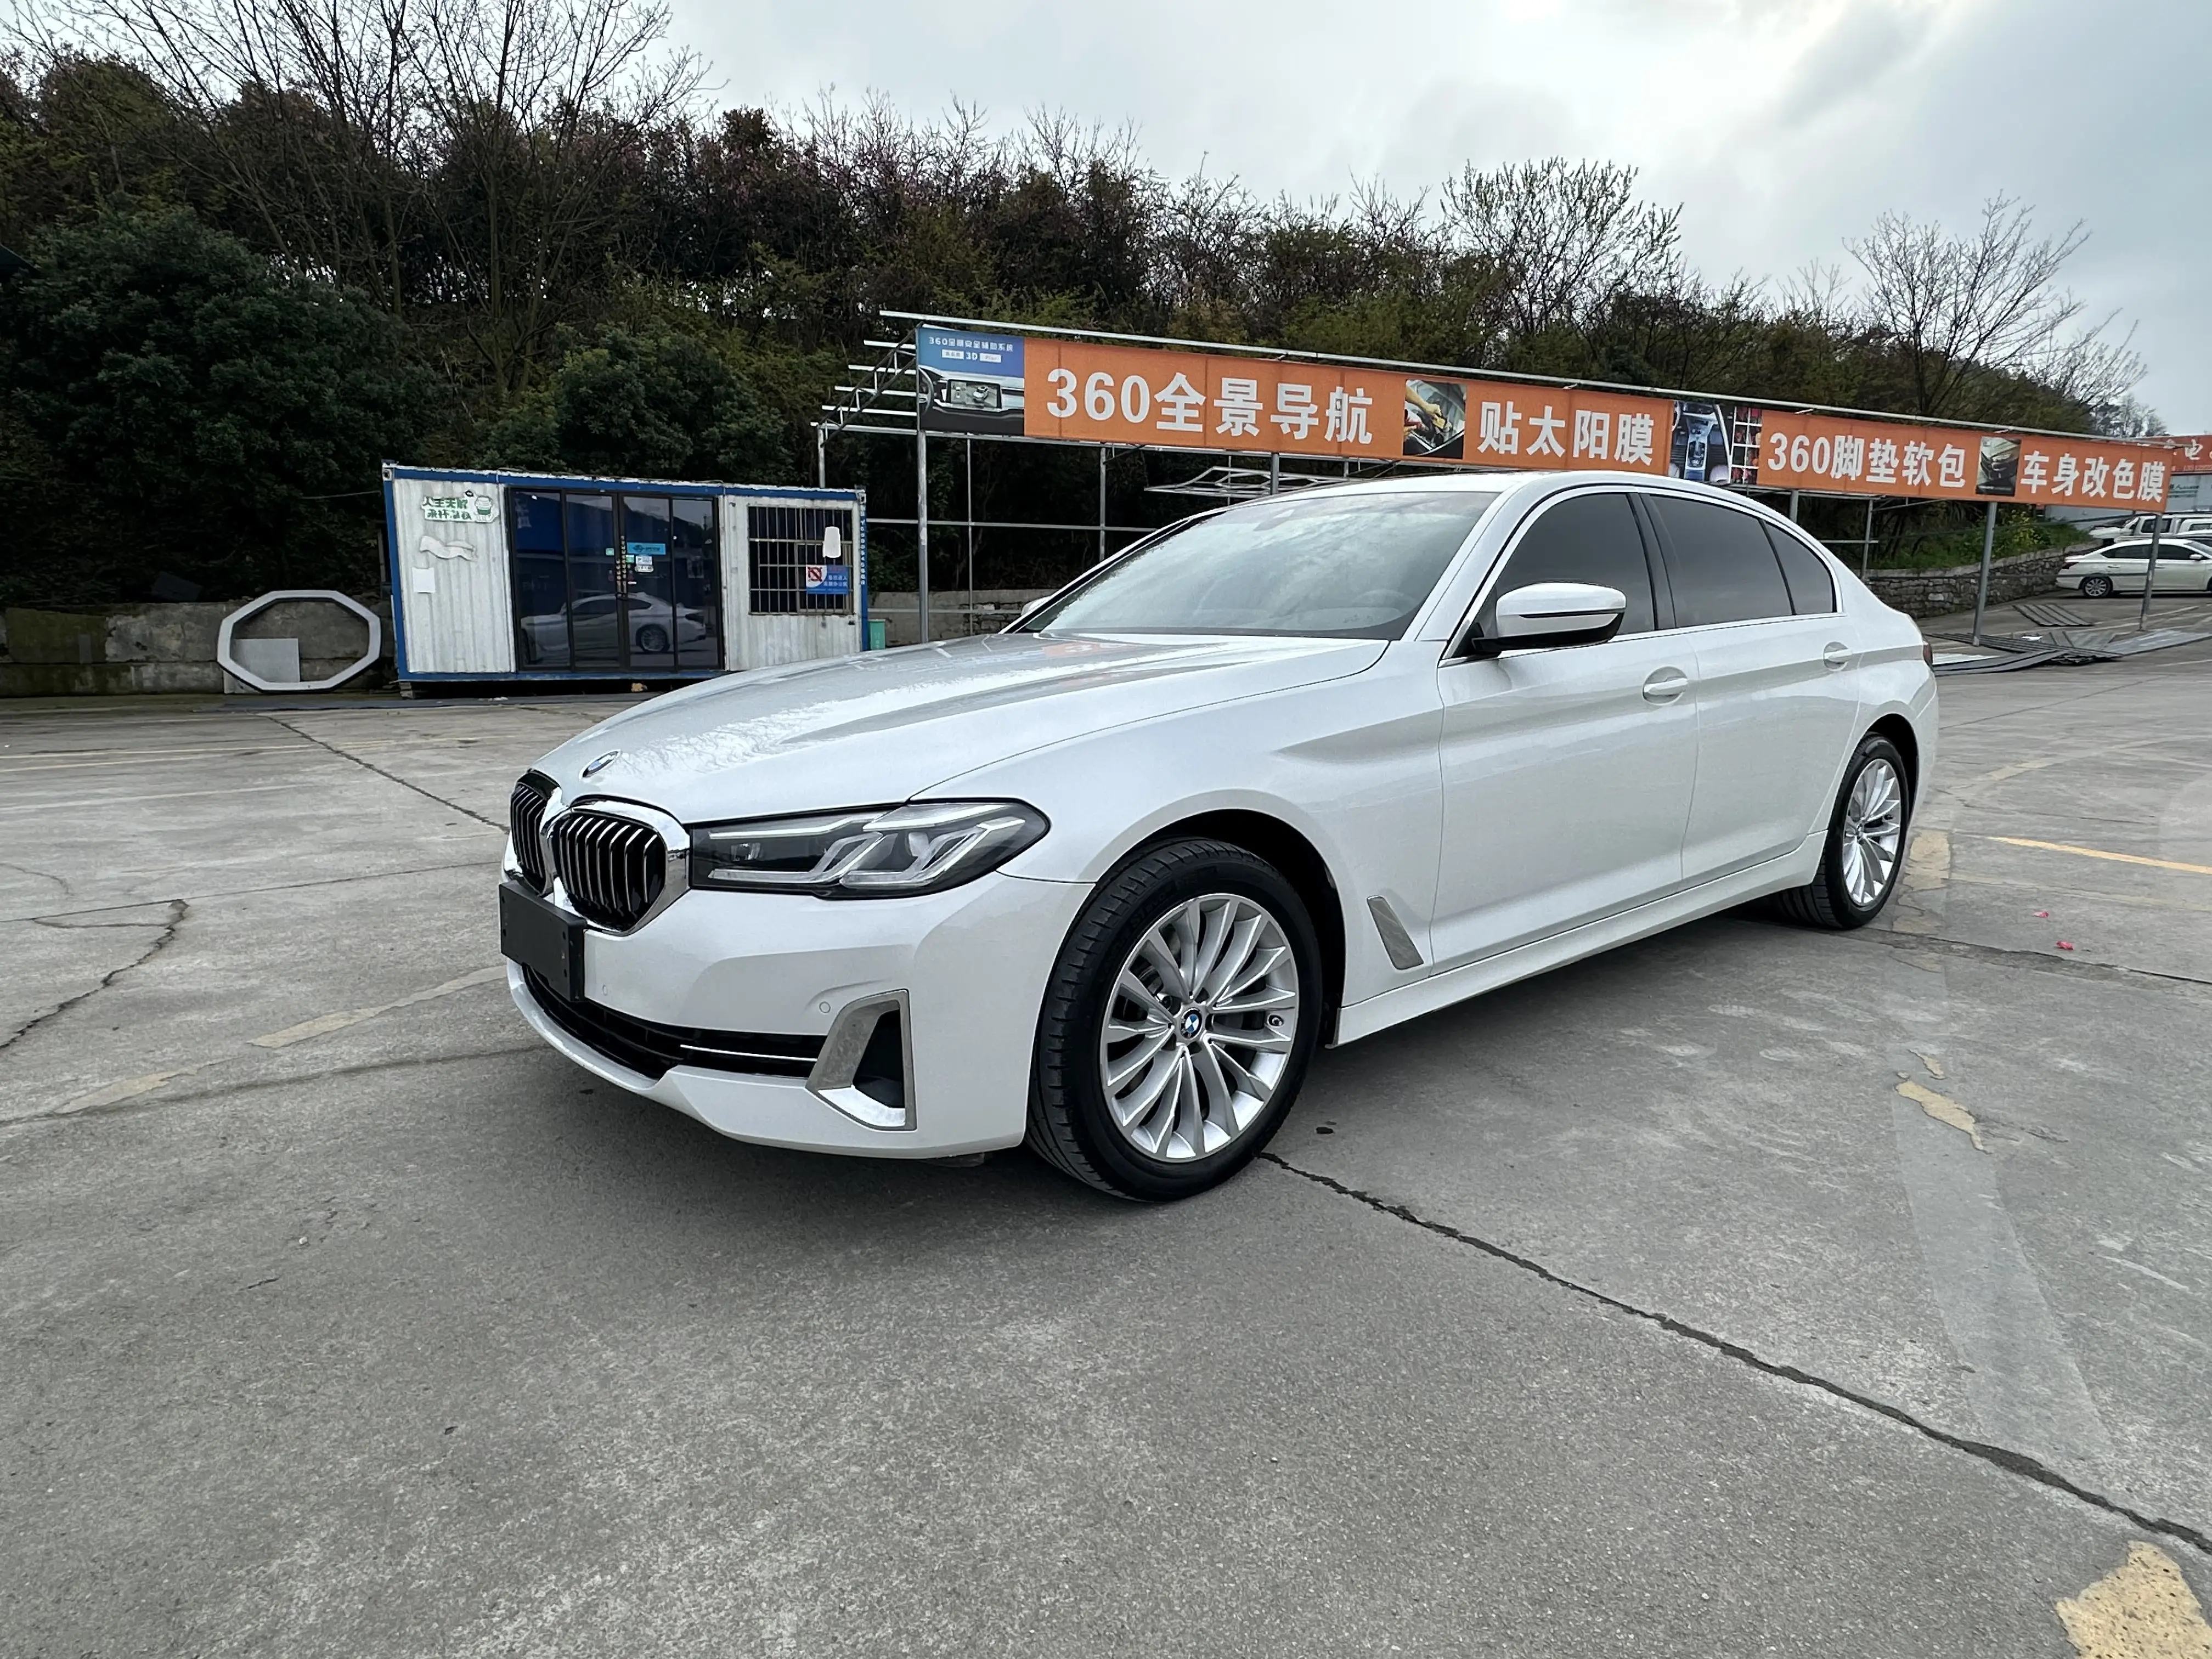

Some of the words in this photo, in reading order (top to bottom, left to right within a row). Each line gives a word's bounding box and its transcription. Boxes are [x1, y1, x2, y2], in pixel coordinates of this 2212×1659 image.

[966, 351, 978, 360] 3D
[1047, 368, 1373, 444] 360全景导航
[1477, 401, 1654, 465] 贴太阳膜
[1768, 432, 1966, 488] 360脚垫软包
[2020, 450, 2165, 503] 车身改色膜
